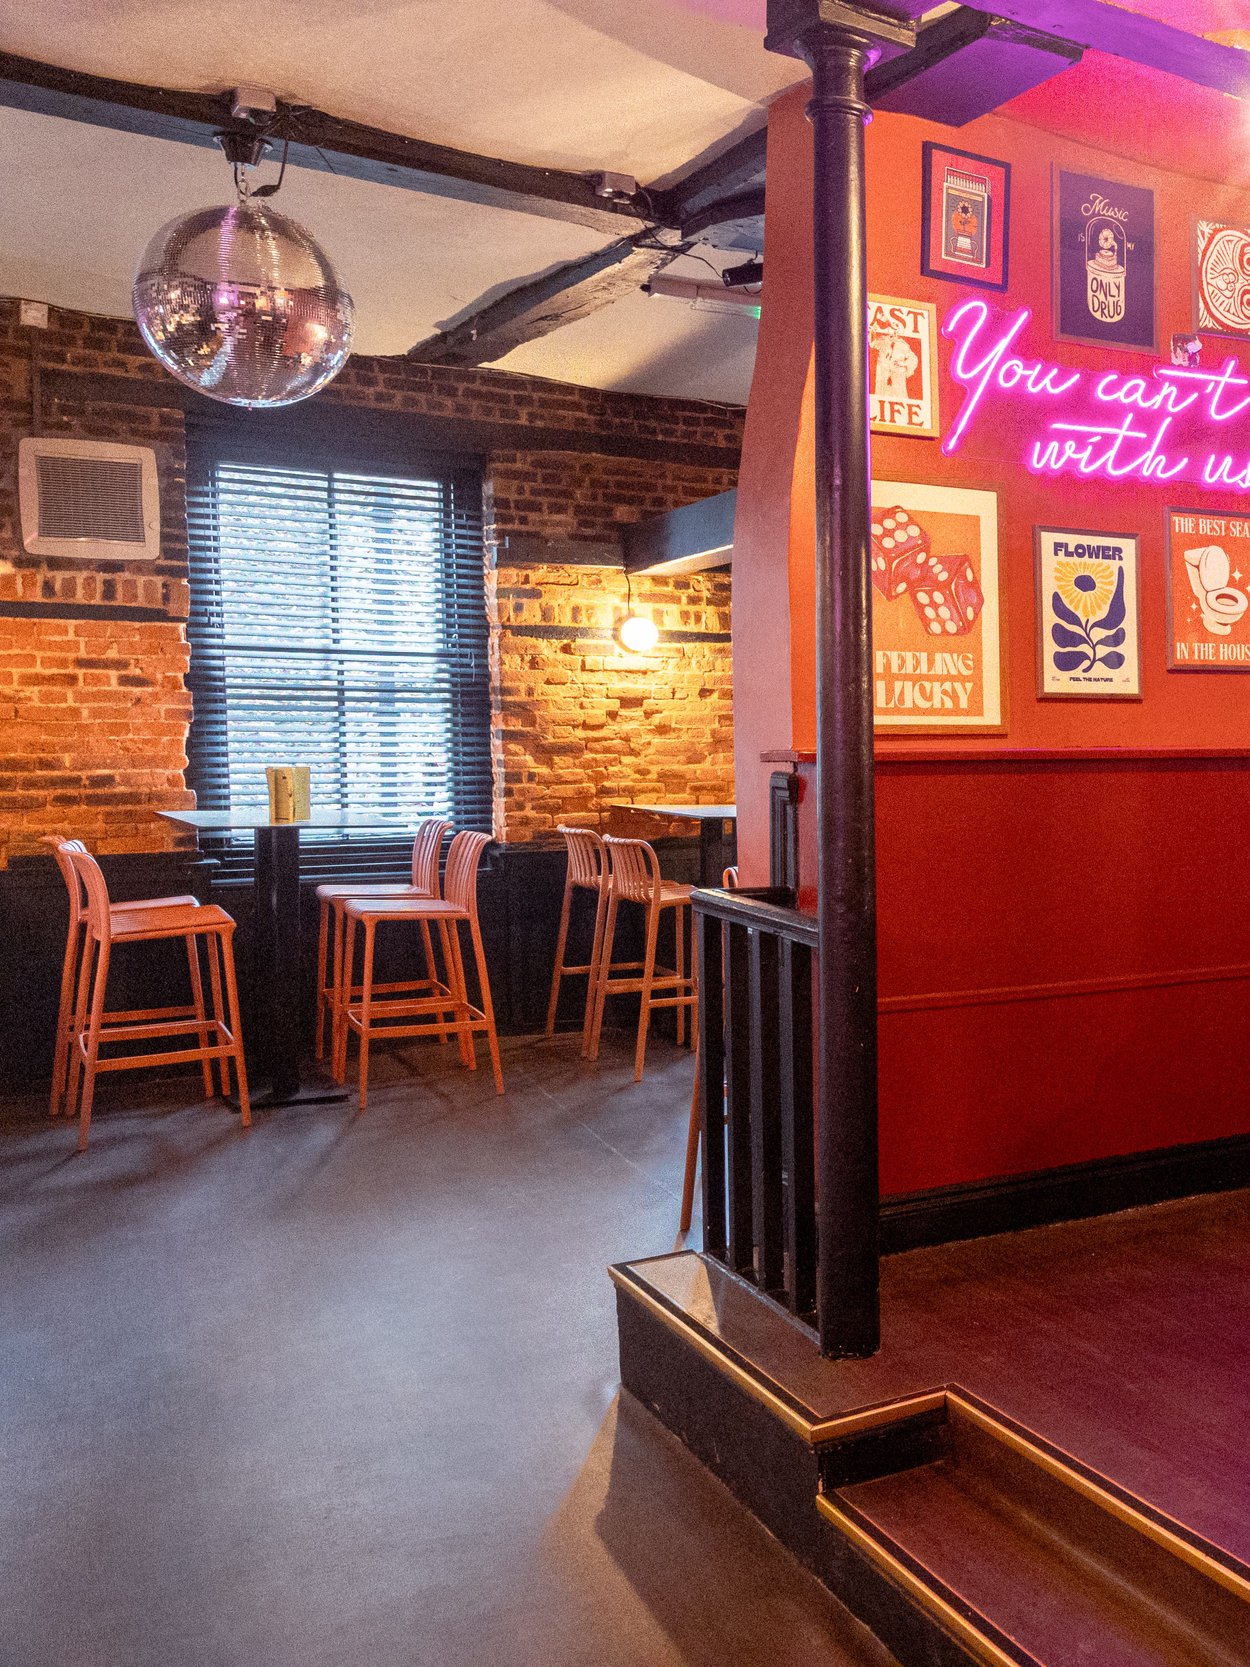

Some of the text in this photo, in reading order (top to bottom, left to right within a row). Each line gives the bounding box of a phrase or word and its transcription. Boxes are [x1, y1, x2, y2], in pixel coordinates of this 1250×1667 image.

[1081, 193, 1129, 222] Music
[1090, 277, 1120, 300] ONLY
[868, 304, 926, 334] AST
[1091, 295, 1122, 319] DRUG
[948, 300, 1080, 451] You
[1033, 413, 1189, 479] with
[1172, 516, 1196, 534] THE
[1199, 518, 1226, 536] BEST
[1053, 541, 1124, 561] FLOWER
[875, 650, 974, 676] FEELING
[1176, 642, 1189, 660] IN
[1192, 642, 1216, 660] THE
[876, 681, 974, 709] LUCKY
